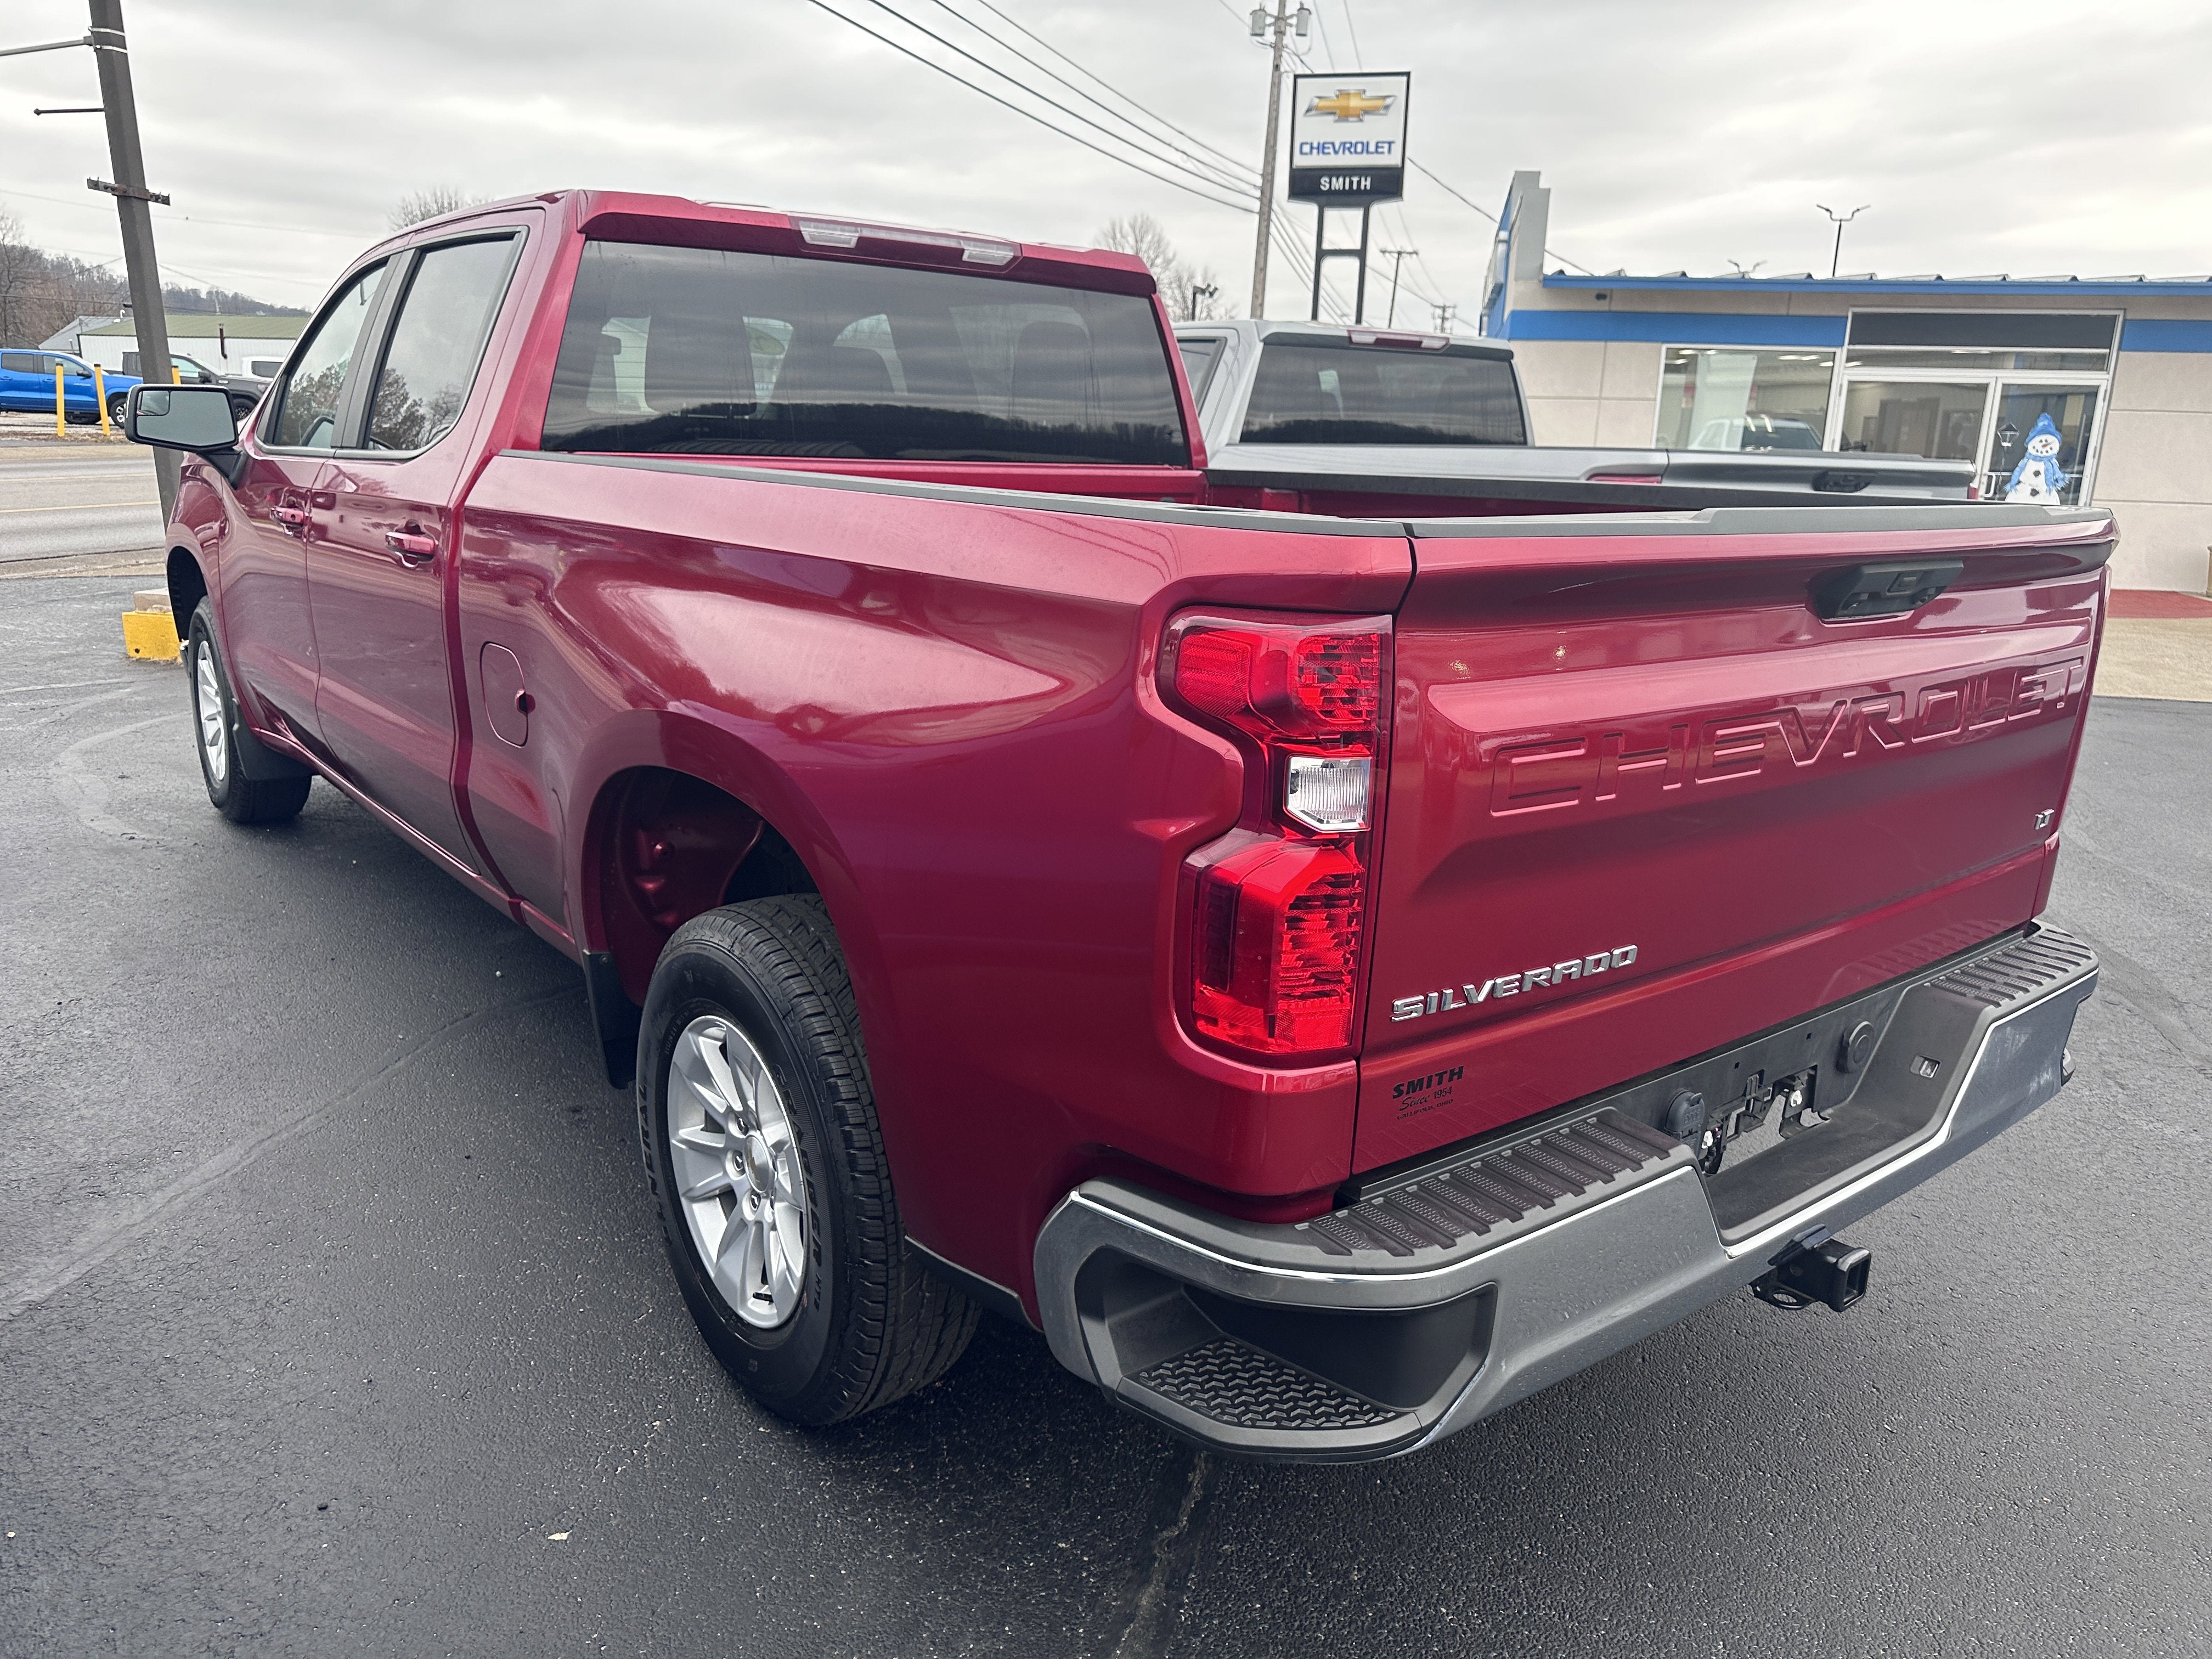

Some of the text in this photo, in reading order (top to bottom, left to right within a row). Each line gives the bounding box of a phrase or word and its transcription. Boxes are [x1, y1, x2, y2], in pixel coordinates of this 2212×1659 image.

[1299, 140, 1395, 155] CHEVROLET
[1319, 175, 1372, 191] SMITH
[1489, 656, 2084, 817] CHEVROLET
[1390, 944, 1638, 1023] SILVERADO
[1392, 1065, 1464, 1099] SMITH
[1399, 1086, 1453, 1111] Since 1954
[1436, 1098, 1454, 1108] OHIO
